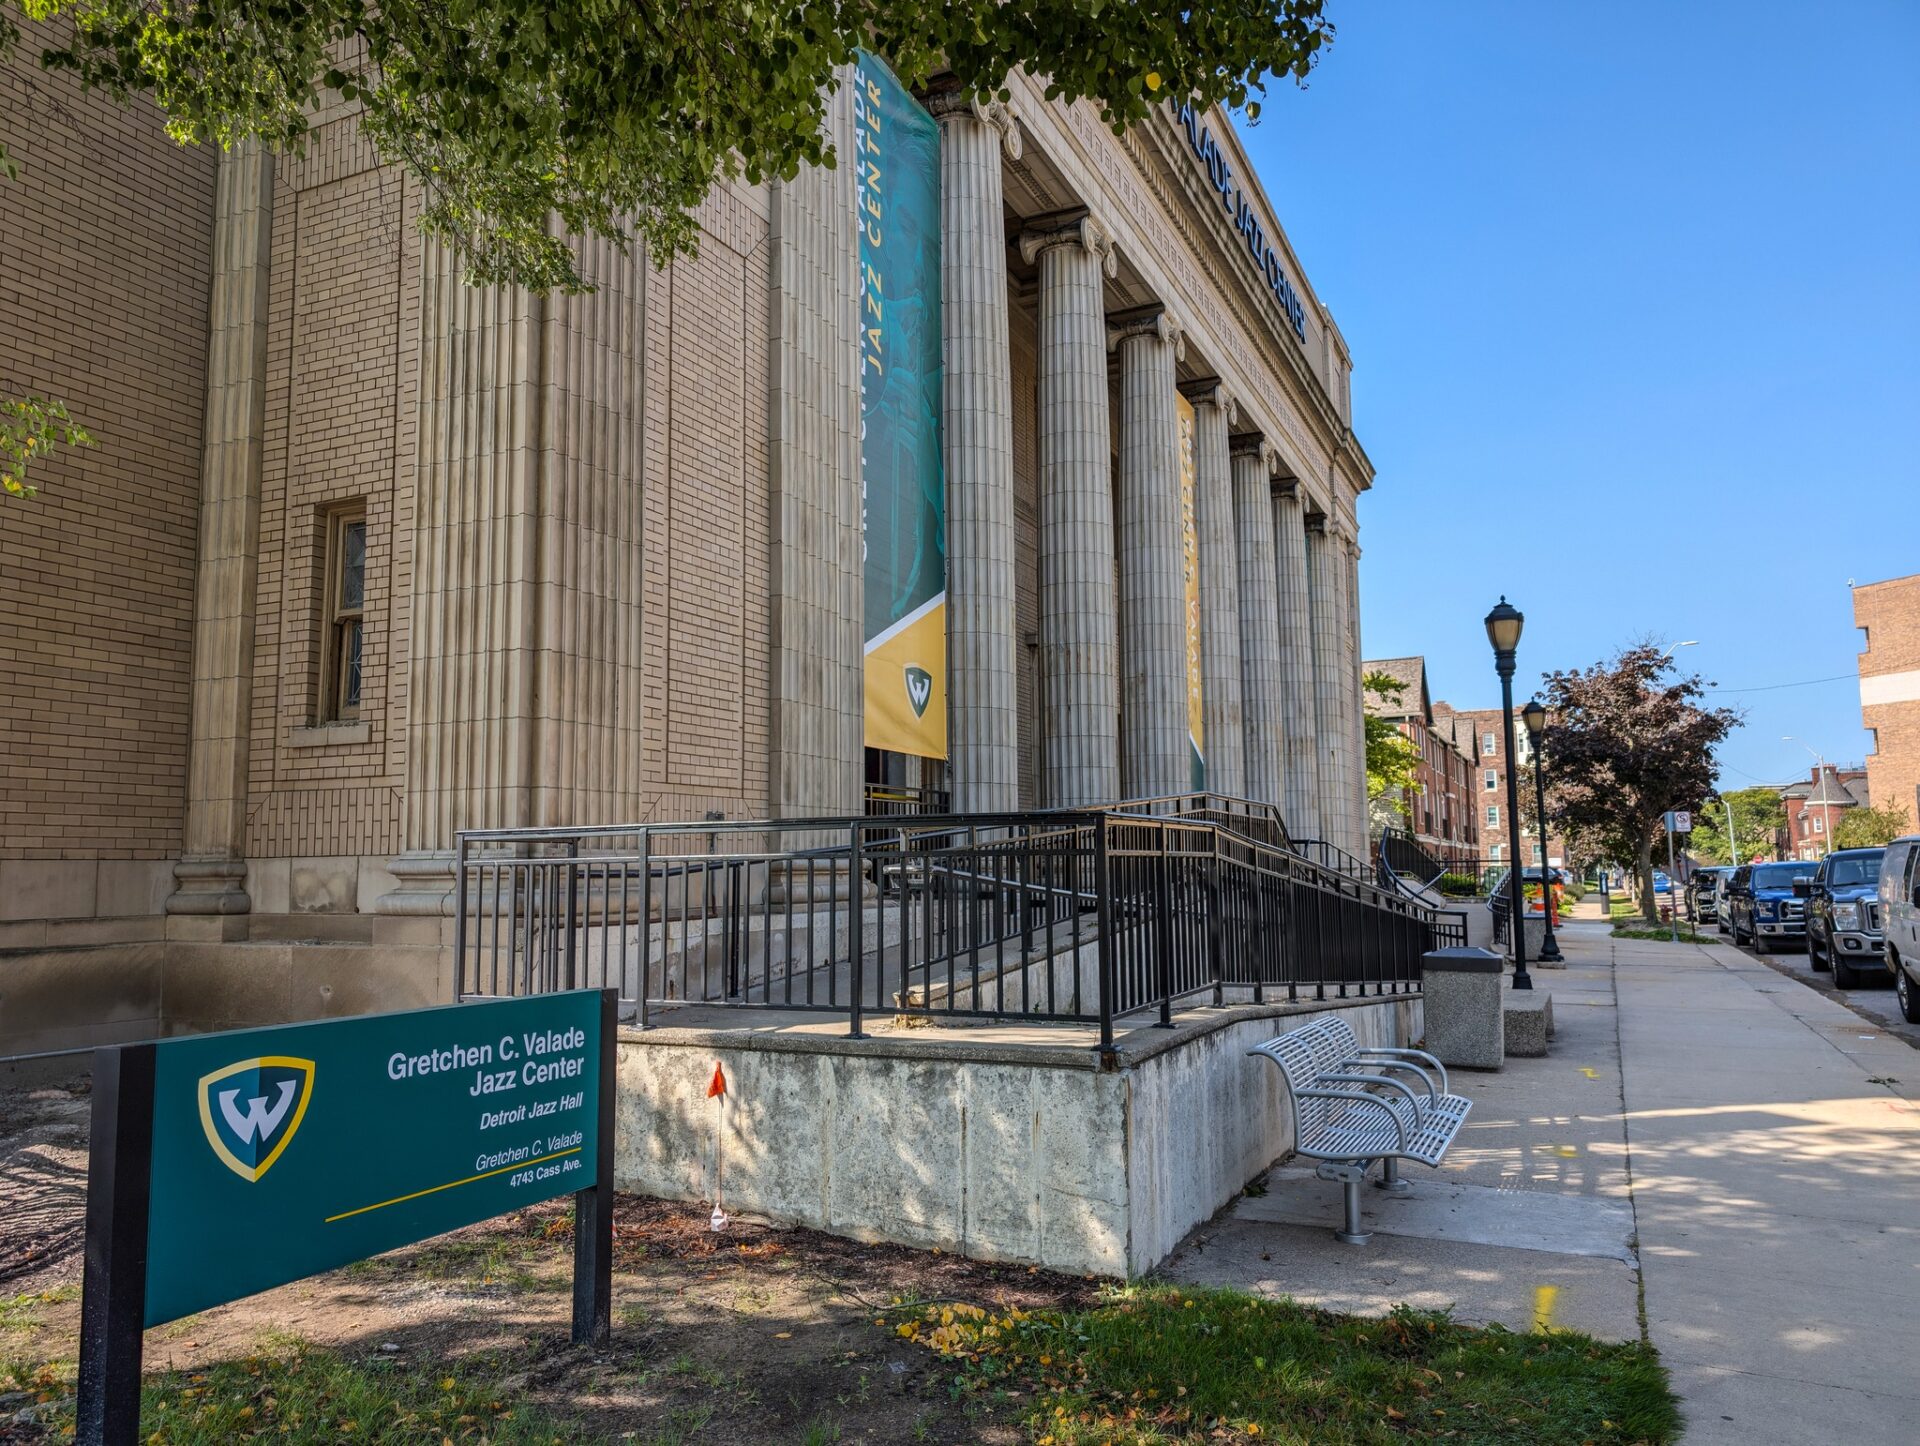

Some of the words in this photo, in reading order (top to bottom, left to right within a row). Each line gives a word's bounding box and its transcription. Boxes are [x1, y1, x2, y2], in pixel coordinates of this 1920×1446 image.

[867, 79, 881, 248] CENTER
[1171, 96, 1233, 214] ALADE
[1234, 190, 1265, 272] JAZZ
[1266, 247, 1307, 345] CENTER
[867, 264, 882, 376] JAZZ
[1180, 413, 1188, 475] JAZZ
[1183, 486, 1191, 583] CENTER
[387, 1044, 492, 1080] Gretchen
[499, 1035, 519, 1061] C.
[523, 1027, 585, 1055] Valade
[469, 1070, 516, 1096] Jazz
[522, 1057, 584, 1086] Center
[219, 1079, 297, 1145] W
[480, 1104, 526, 1130] Detroit
[528, 1100, 556, 1120] Jazz
[559, 1092, 583, 1112] Hall
[476, 1145, 529, 1171] Gretchen
[531, 1140, 543, 1156] C.
[547, 1131, 582, 1151] Valade
[510, 1171, 534, 1187] 4743
[536, 1165, 560, 1180] Cass
[562, 1159, 582, 1173] Ave.
